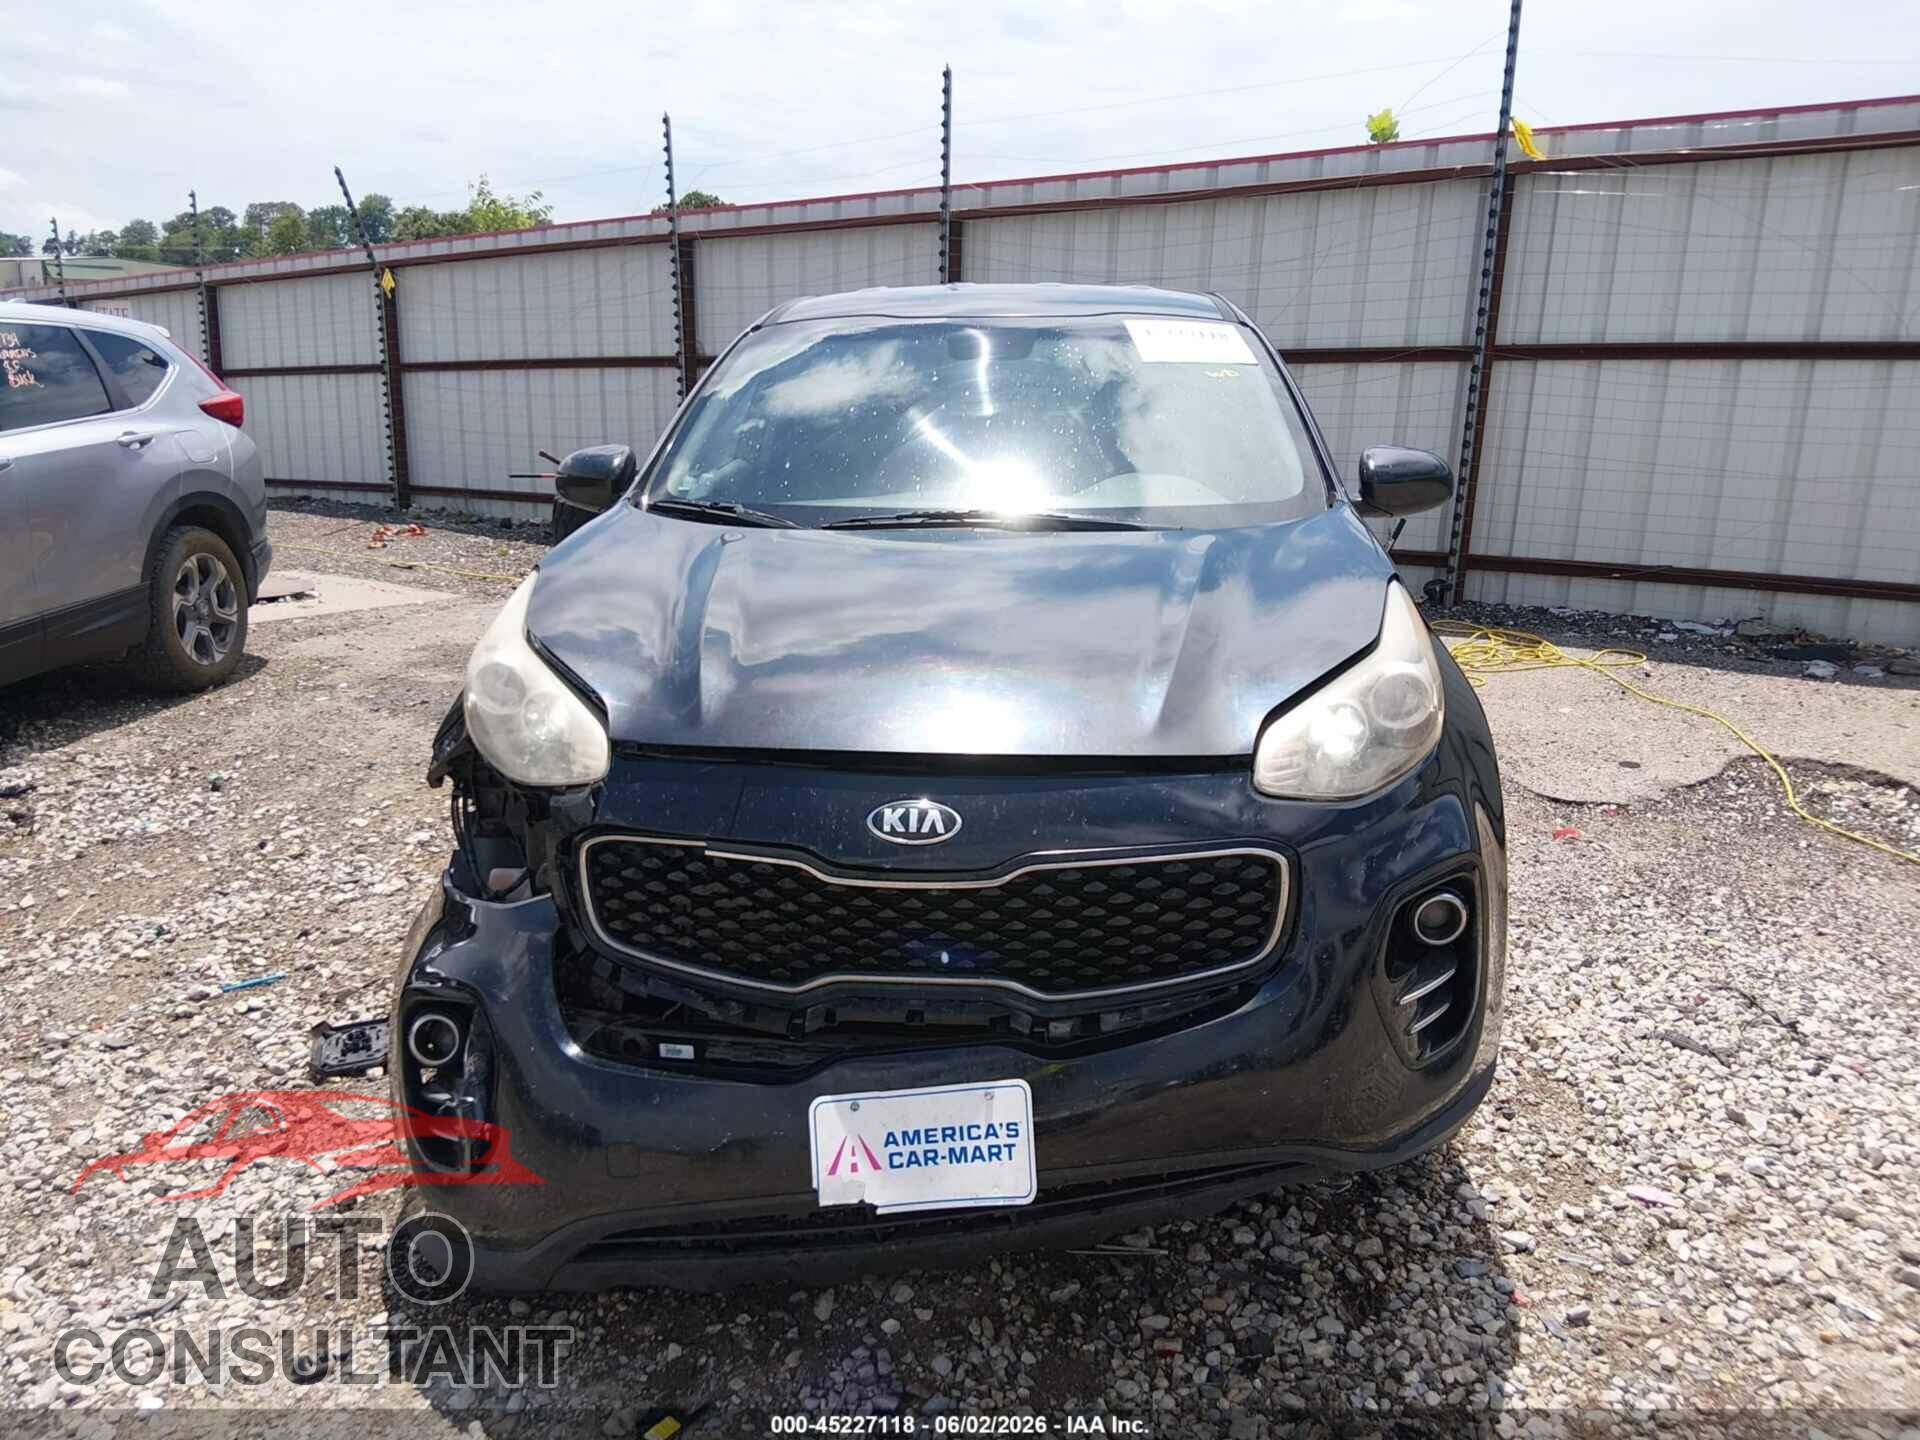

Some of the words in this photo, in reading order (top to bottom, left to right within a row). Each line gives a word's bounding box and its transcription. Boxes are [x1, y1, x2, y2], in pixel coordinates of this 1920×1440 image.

[882, 807, 945, 834] KIA
[883, 1121, 1020, 1148] AMERICA'S
[888, 1143, 1017, 1170] CAR-MART
